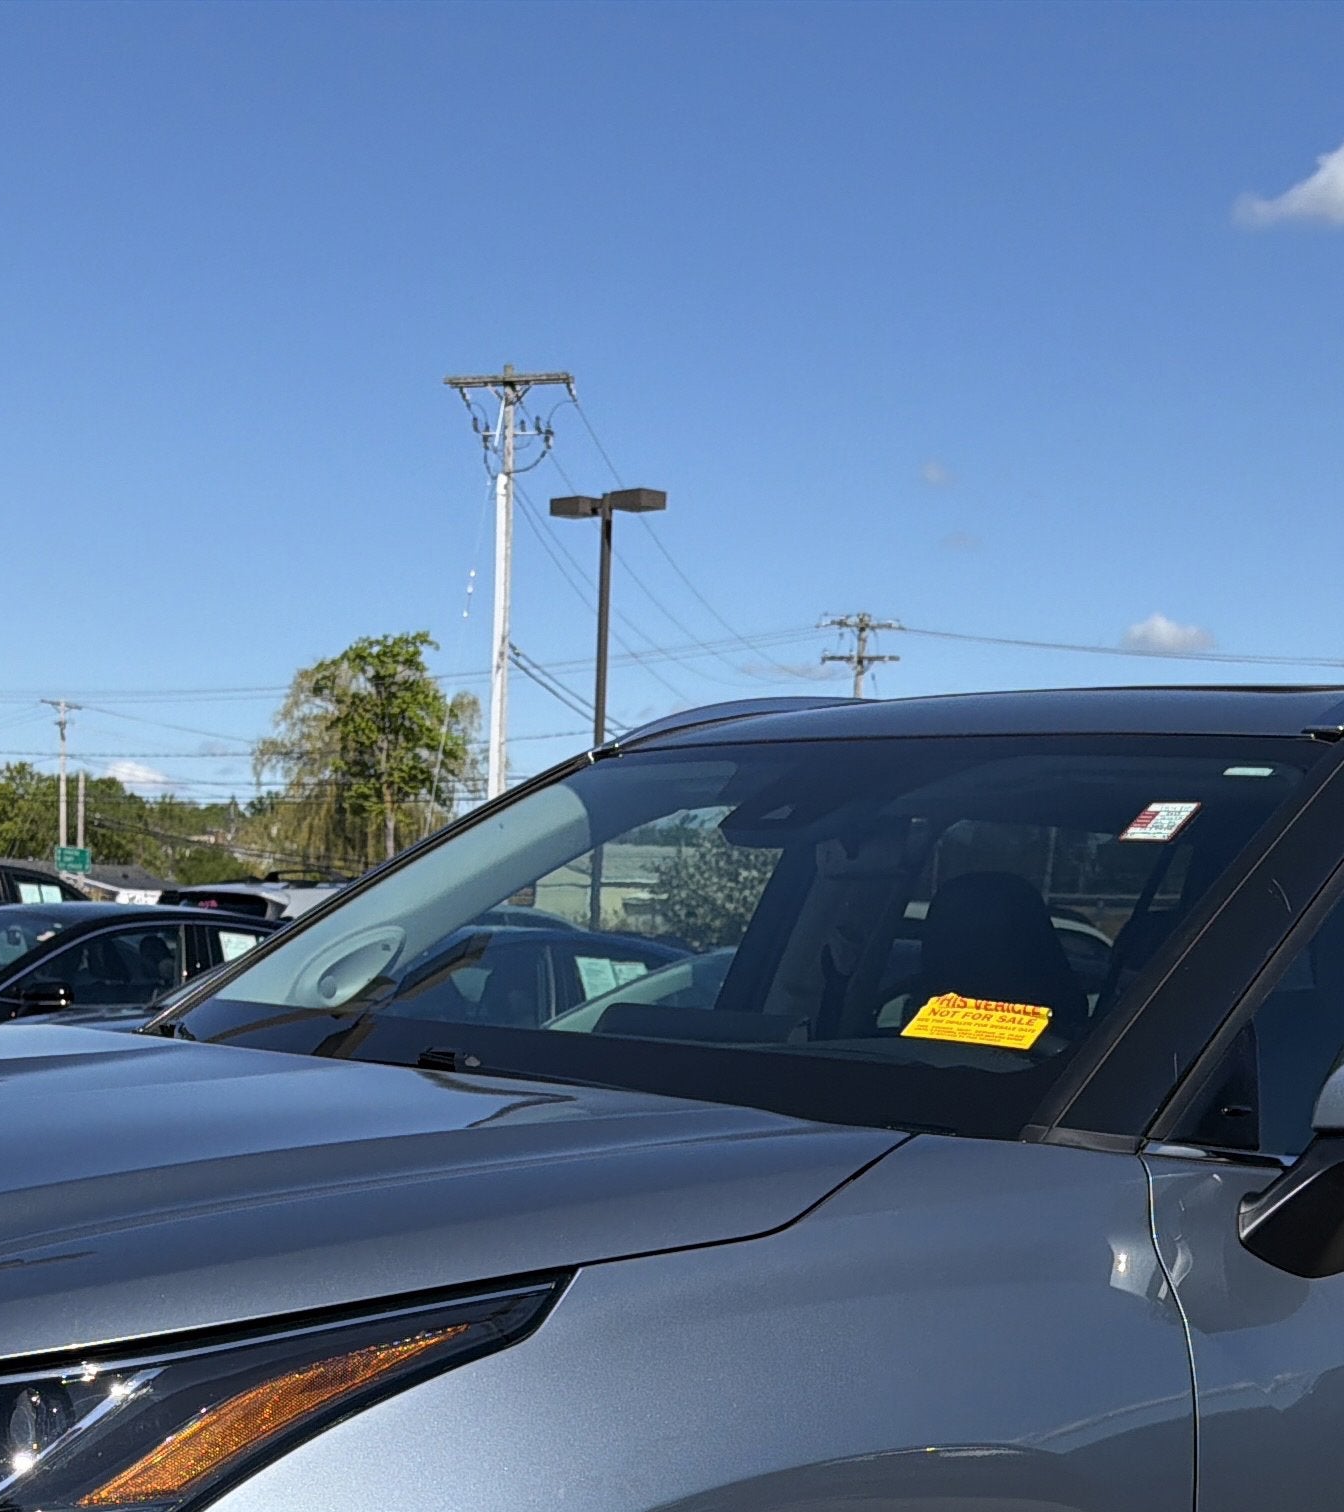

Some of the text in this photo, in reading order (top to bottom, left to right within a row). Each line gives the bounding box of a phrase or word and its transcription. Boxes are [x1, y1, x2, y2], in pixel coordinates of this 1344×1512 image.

[928, 1008, 1037, 1027] NOT FOR SALE
[975, 1000, 1041, 1018] VEHICLE
